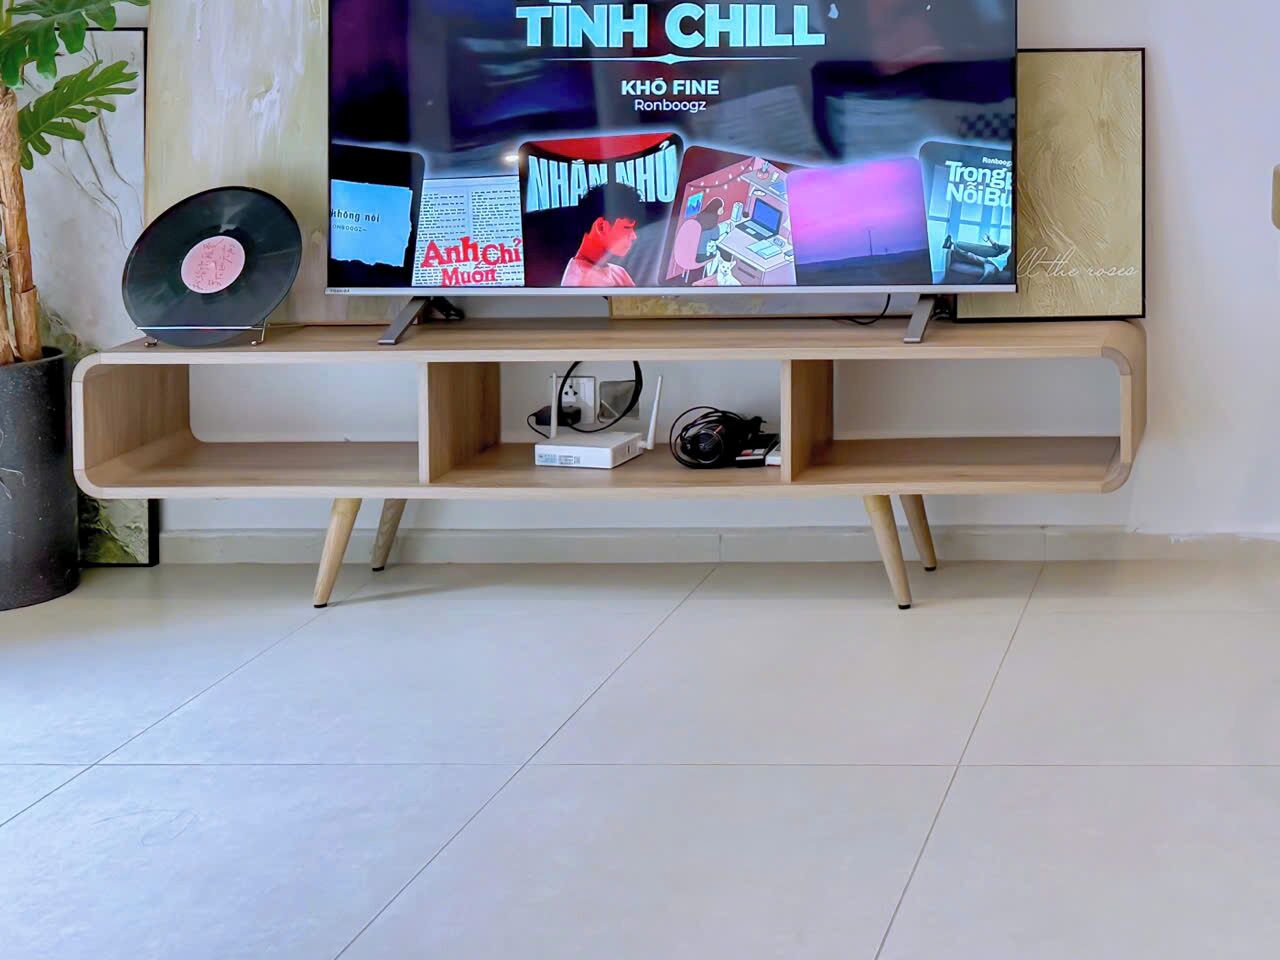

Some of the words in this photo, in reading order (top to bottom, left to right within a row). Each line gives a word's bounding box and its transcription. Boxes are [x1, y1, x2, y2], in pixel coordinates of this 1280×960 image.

[664, 2, 826, 49] CHILL
[621, 77, 667, 96] KHÓ
[672, 79, 720, 95] FINE
[634, 98, 707, 113] Ronboogz
[420, 236, 480, 268] Anh
[481, 238, 522, 266] Chỉ
[1045, 246, 1080, 277] the
[1087, 266, 1138, 277] roses
